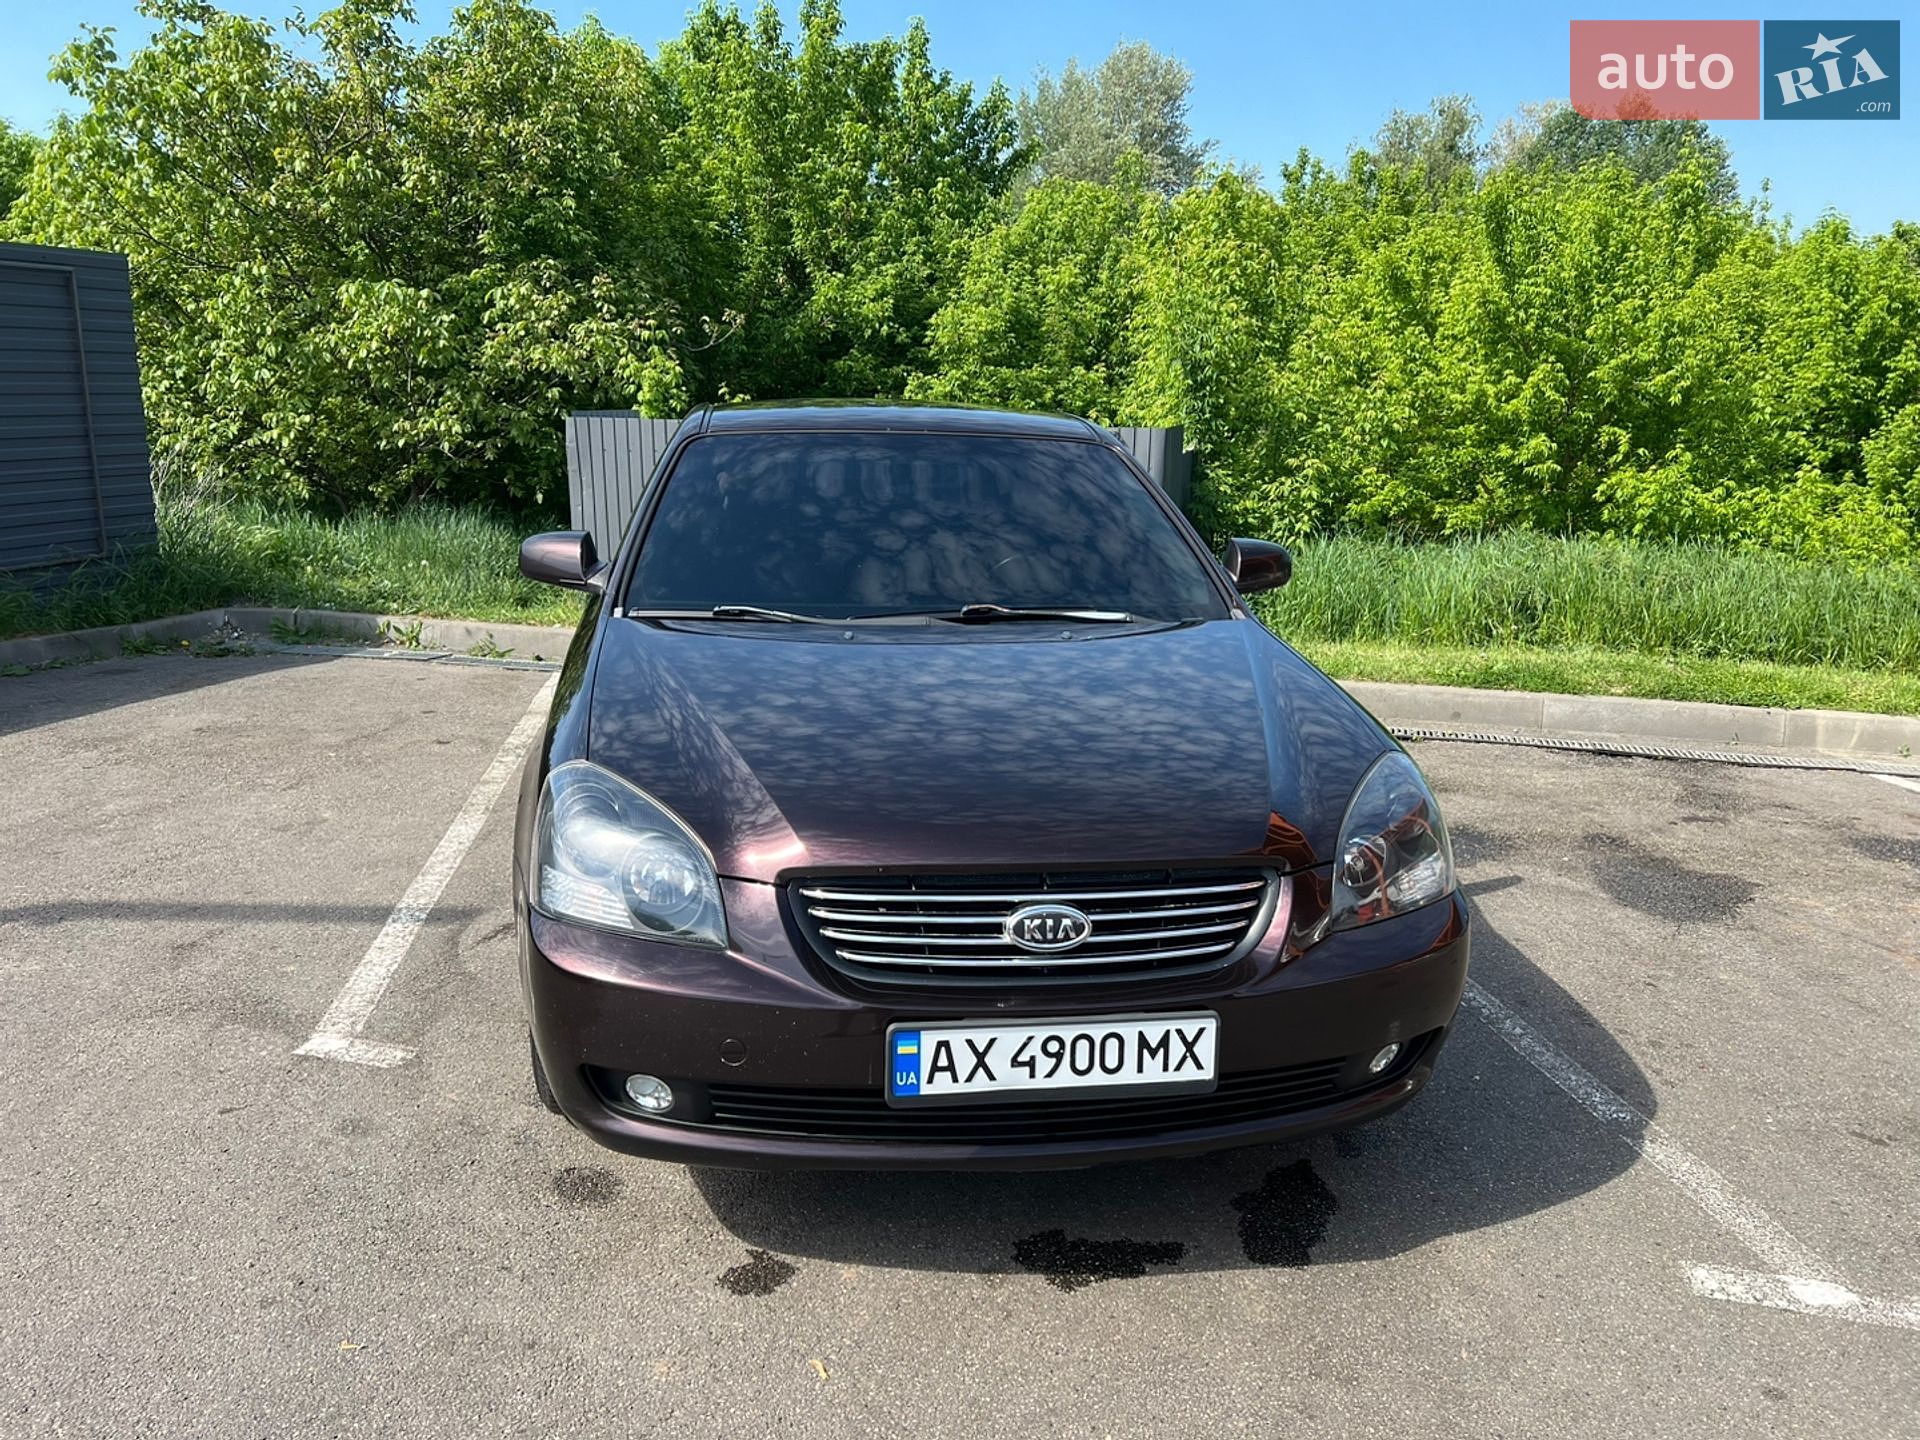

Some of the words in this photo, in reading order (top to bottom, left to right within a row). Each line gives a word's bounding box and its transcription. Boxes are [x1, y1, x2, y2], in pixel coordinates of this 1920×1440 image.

[1023, 918, 1077, 940] KIA
[926, 1037, 998, 1085] AX
[1010, 1031, 1125, 1079] 4900
[1136, 1027, 1207, 1074] MX
[896, 1071, 918, 1086] UA
